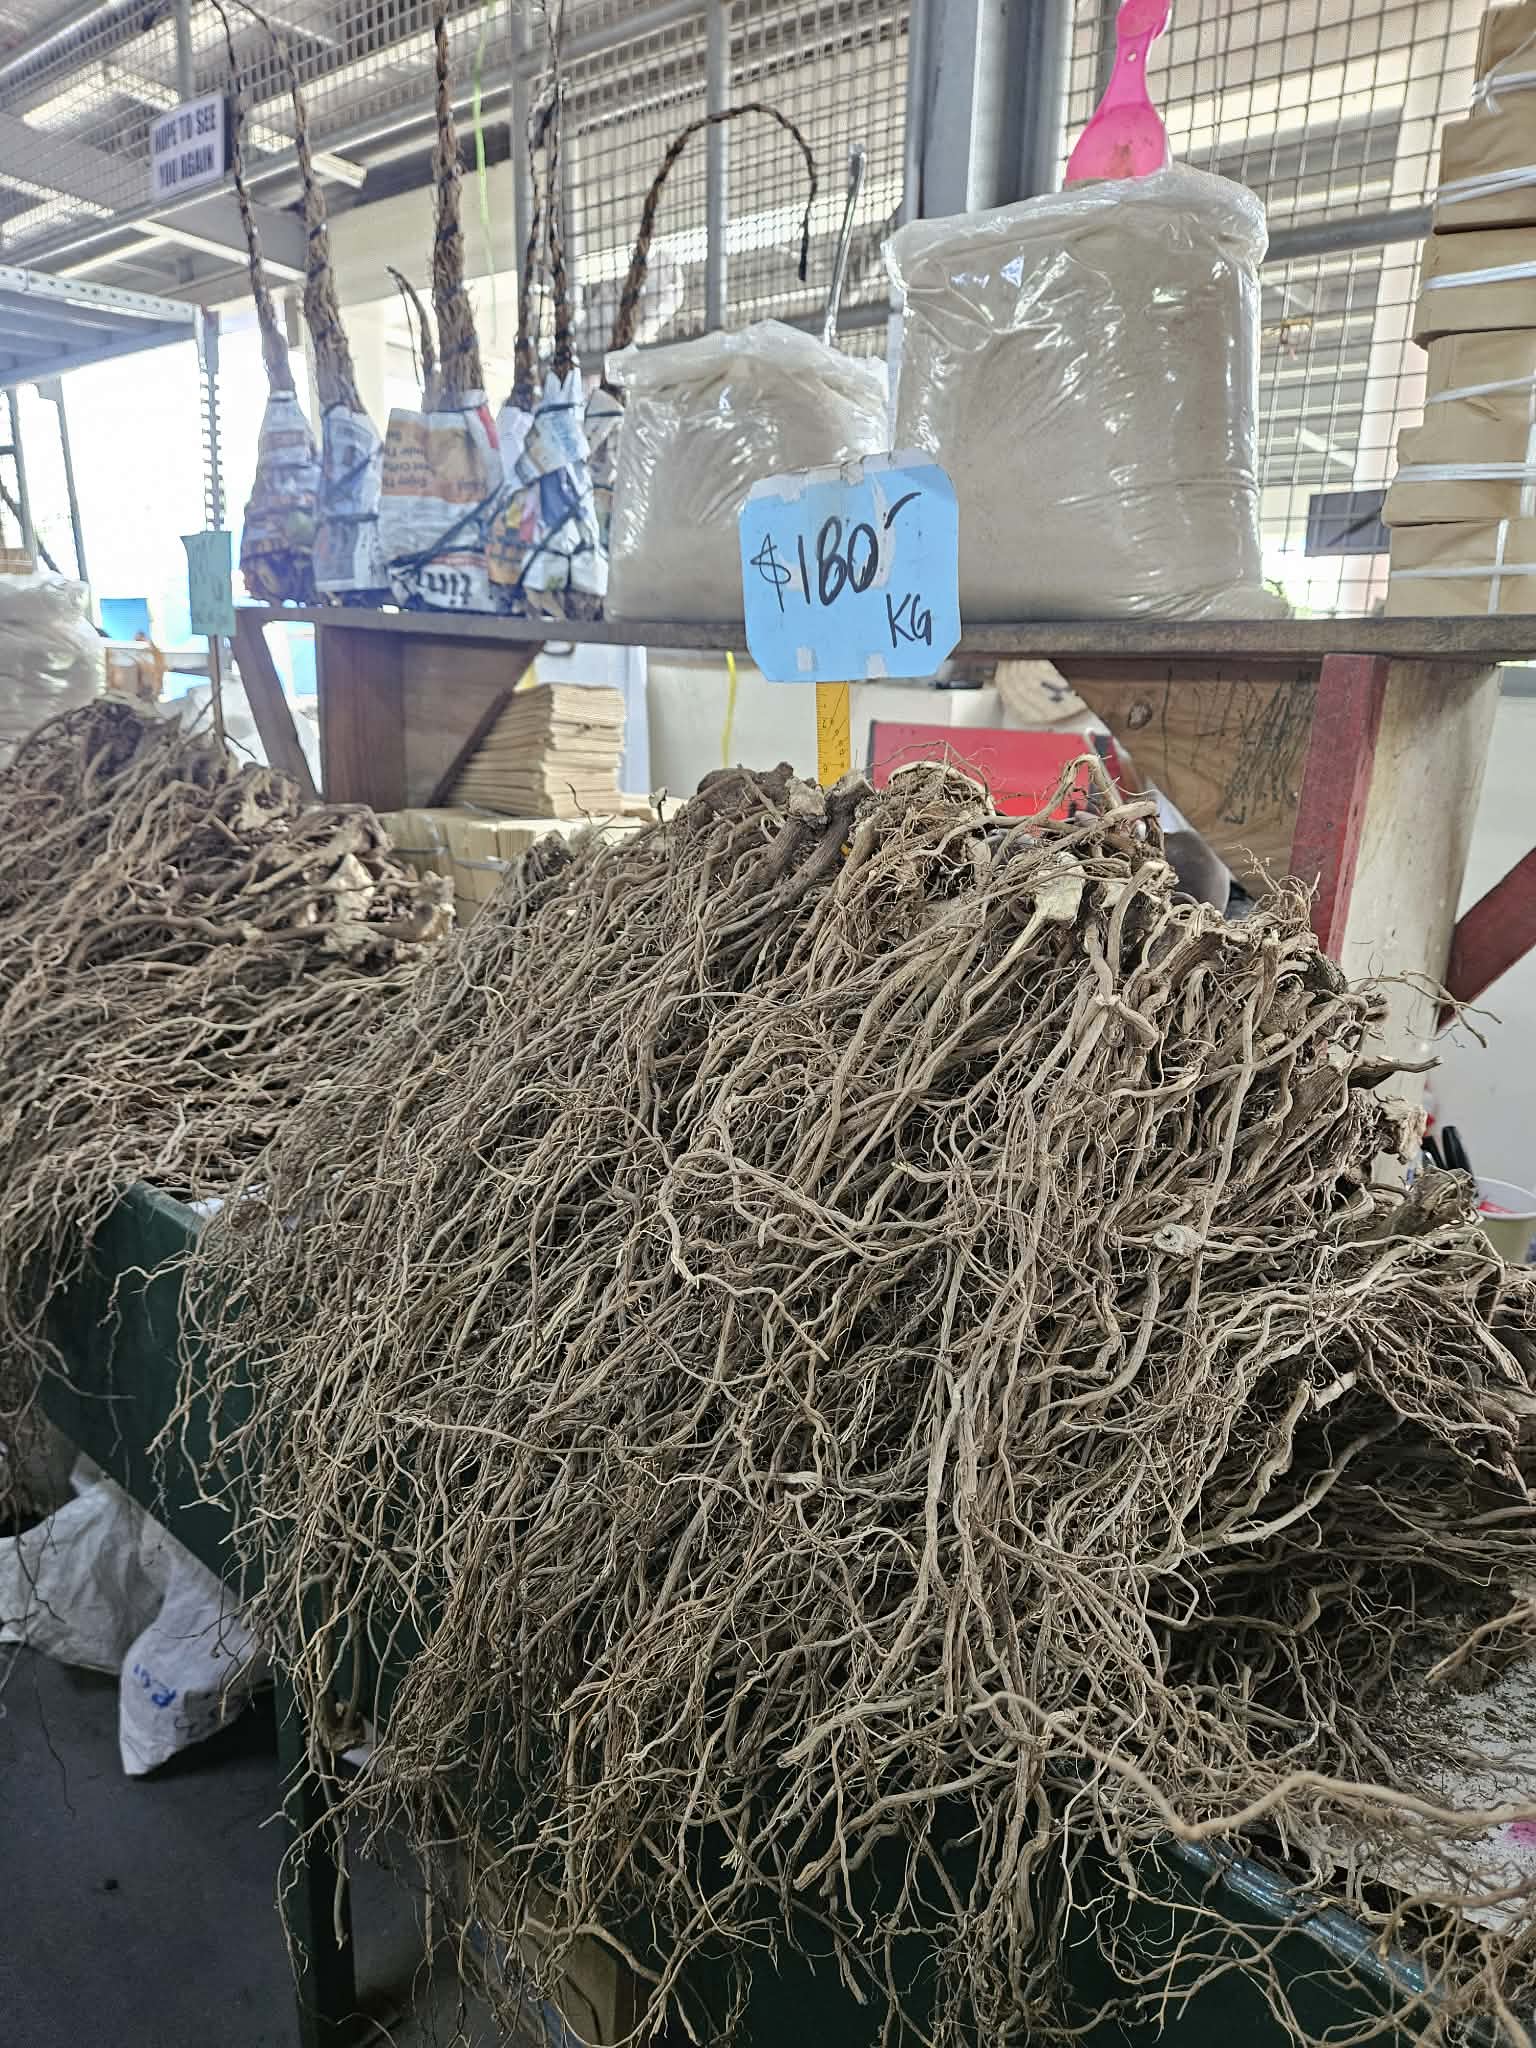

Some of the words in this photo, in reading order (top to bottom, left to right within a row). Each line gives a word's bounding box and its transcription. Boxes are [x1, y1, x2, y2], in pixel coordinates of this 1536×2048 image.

[155, 120, 177, 154] HOPE
[179, 111, 193, 142] TO
[196, 103, 216, 135] SEE
[160, 158, 177, 189] YOU
[181, 143, 214, 179] AGAIN
[886, 593, 932, 648] KG
